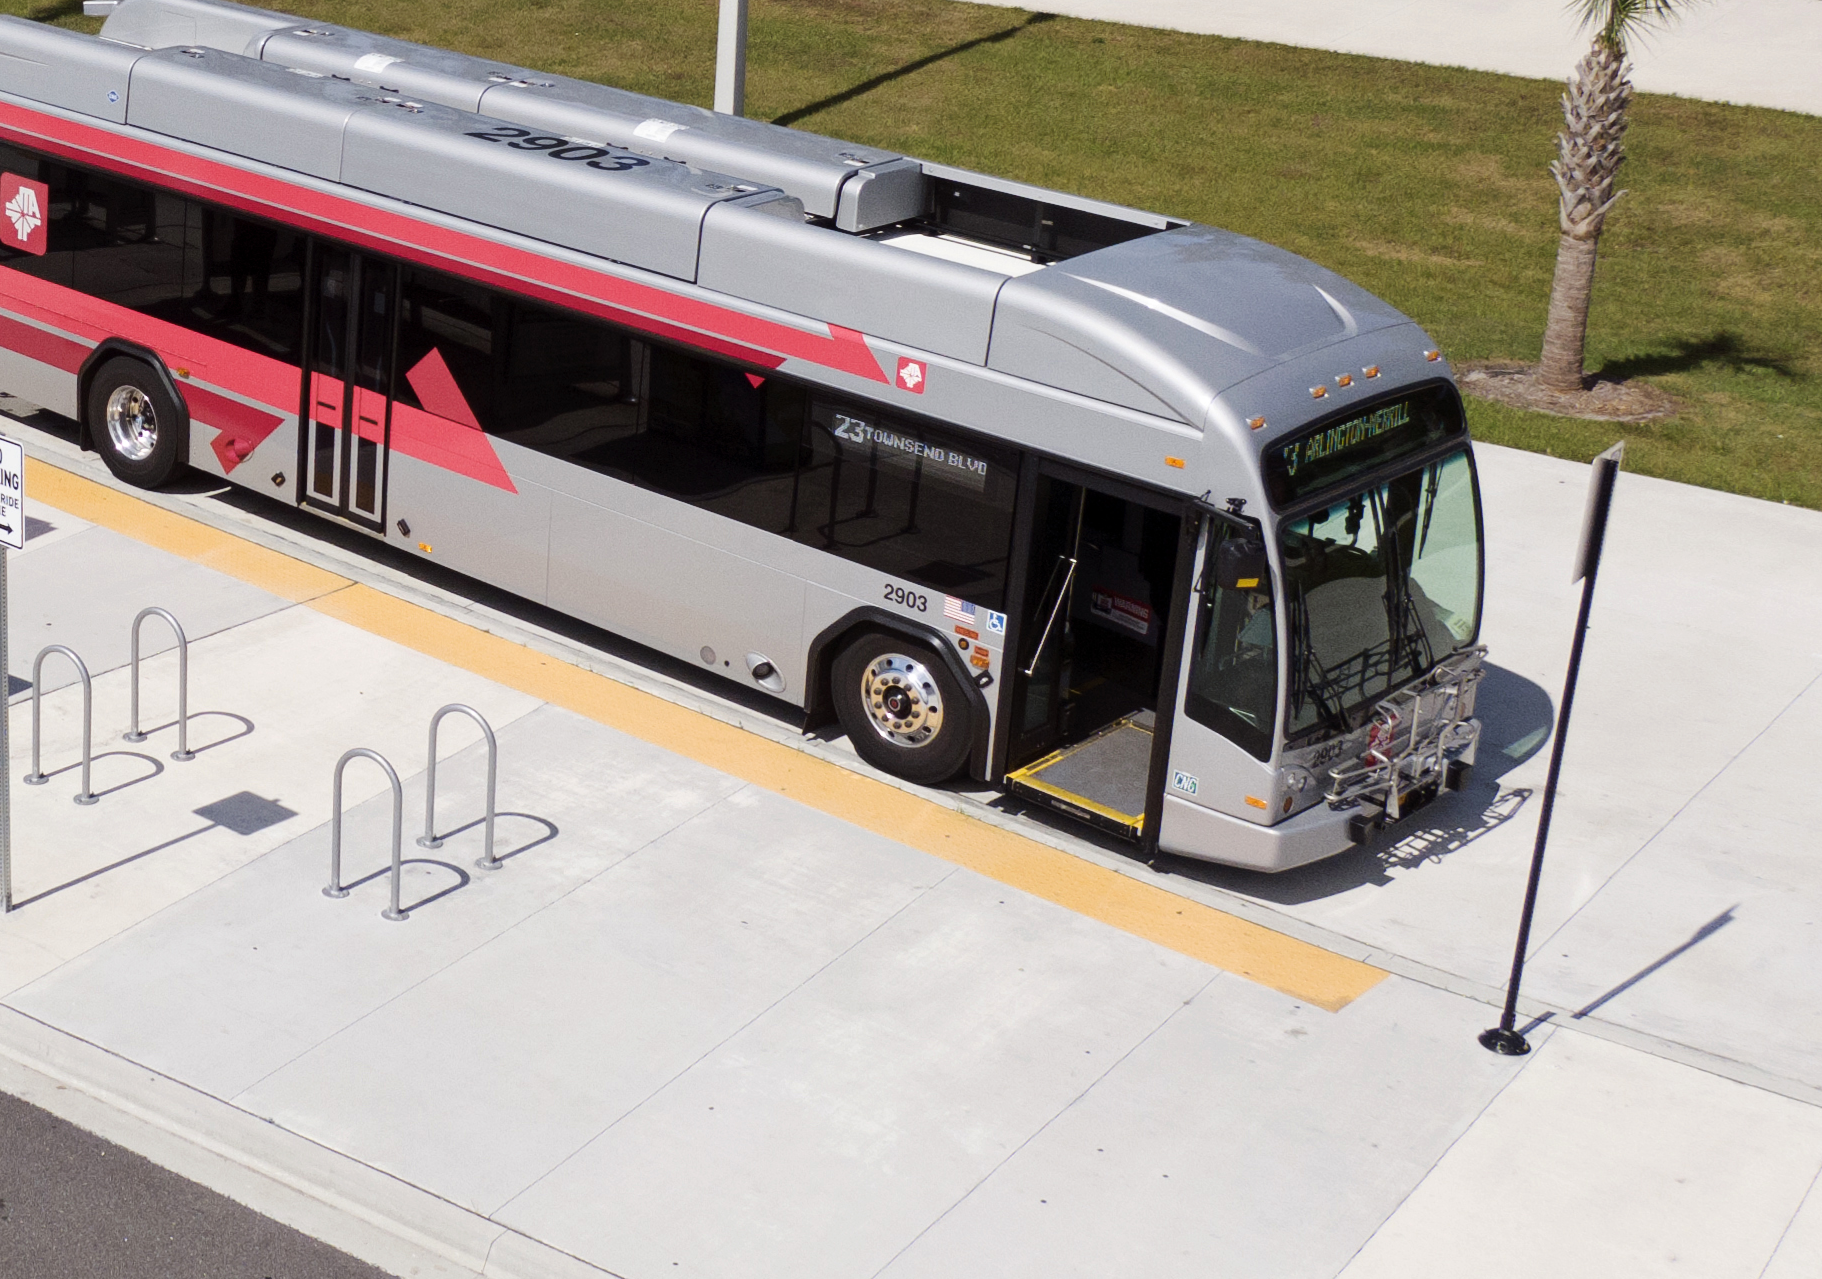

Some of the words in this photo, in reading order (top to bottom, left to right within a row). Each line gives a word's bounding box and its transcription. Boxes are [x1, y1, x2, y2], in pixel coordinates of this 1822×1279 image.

[463, 127, 651, 172] 2903
[834, 414, 866, 443] 23
[864, 426, 944, 462] TOWNSEND
[948, 452, 987, 475] BLVD
[0, 493, 19, 510] RIDE
[883, 583, 928, 613] 2903
[1174, 772, 1197, 795] CNG
